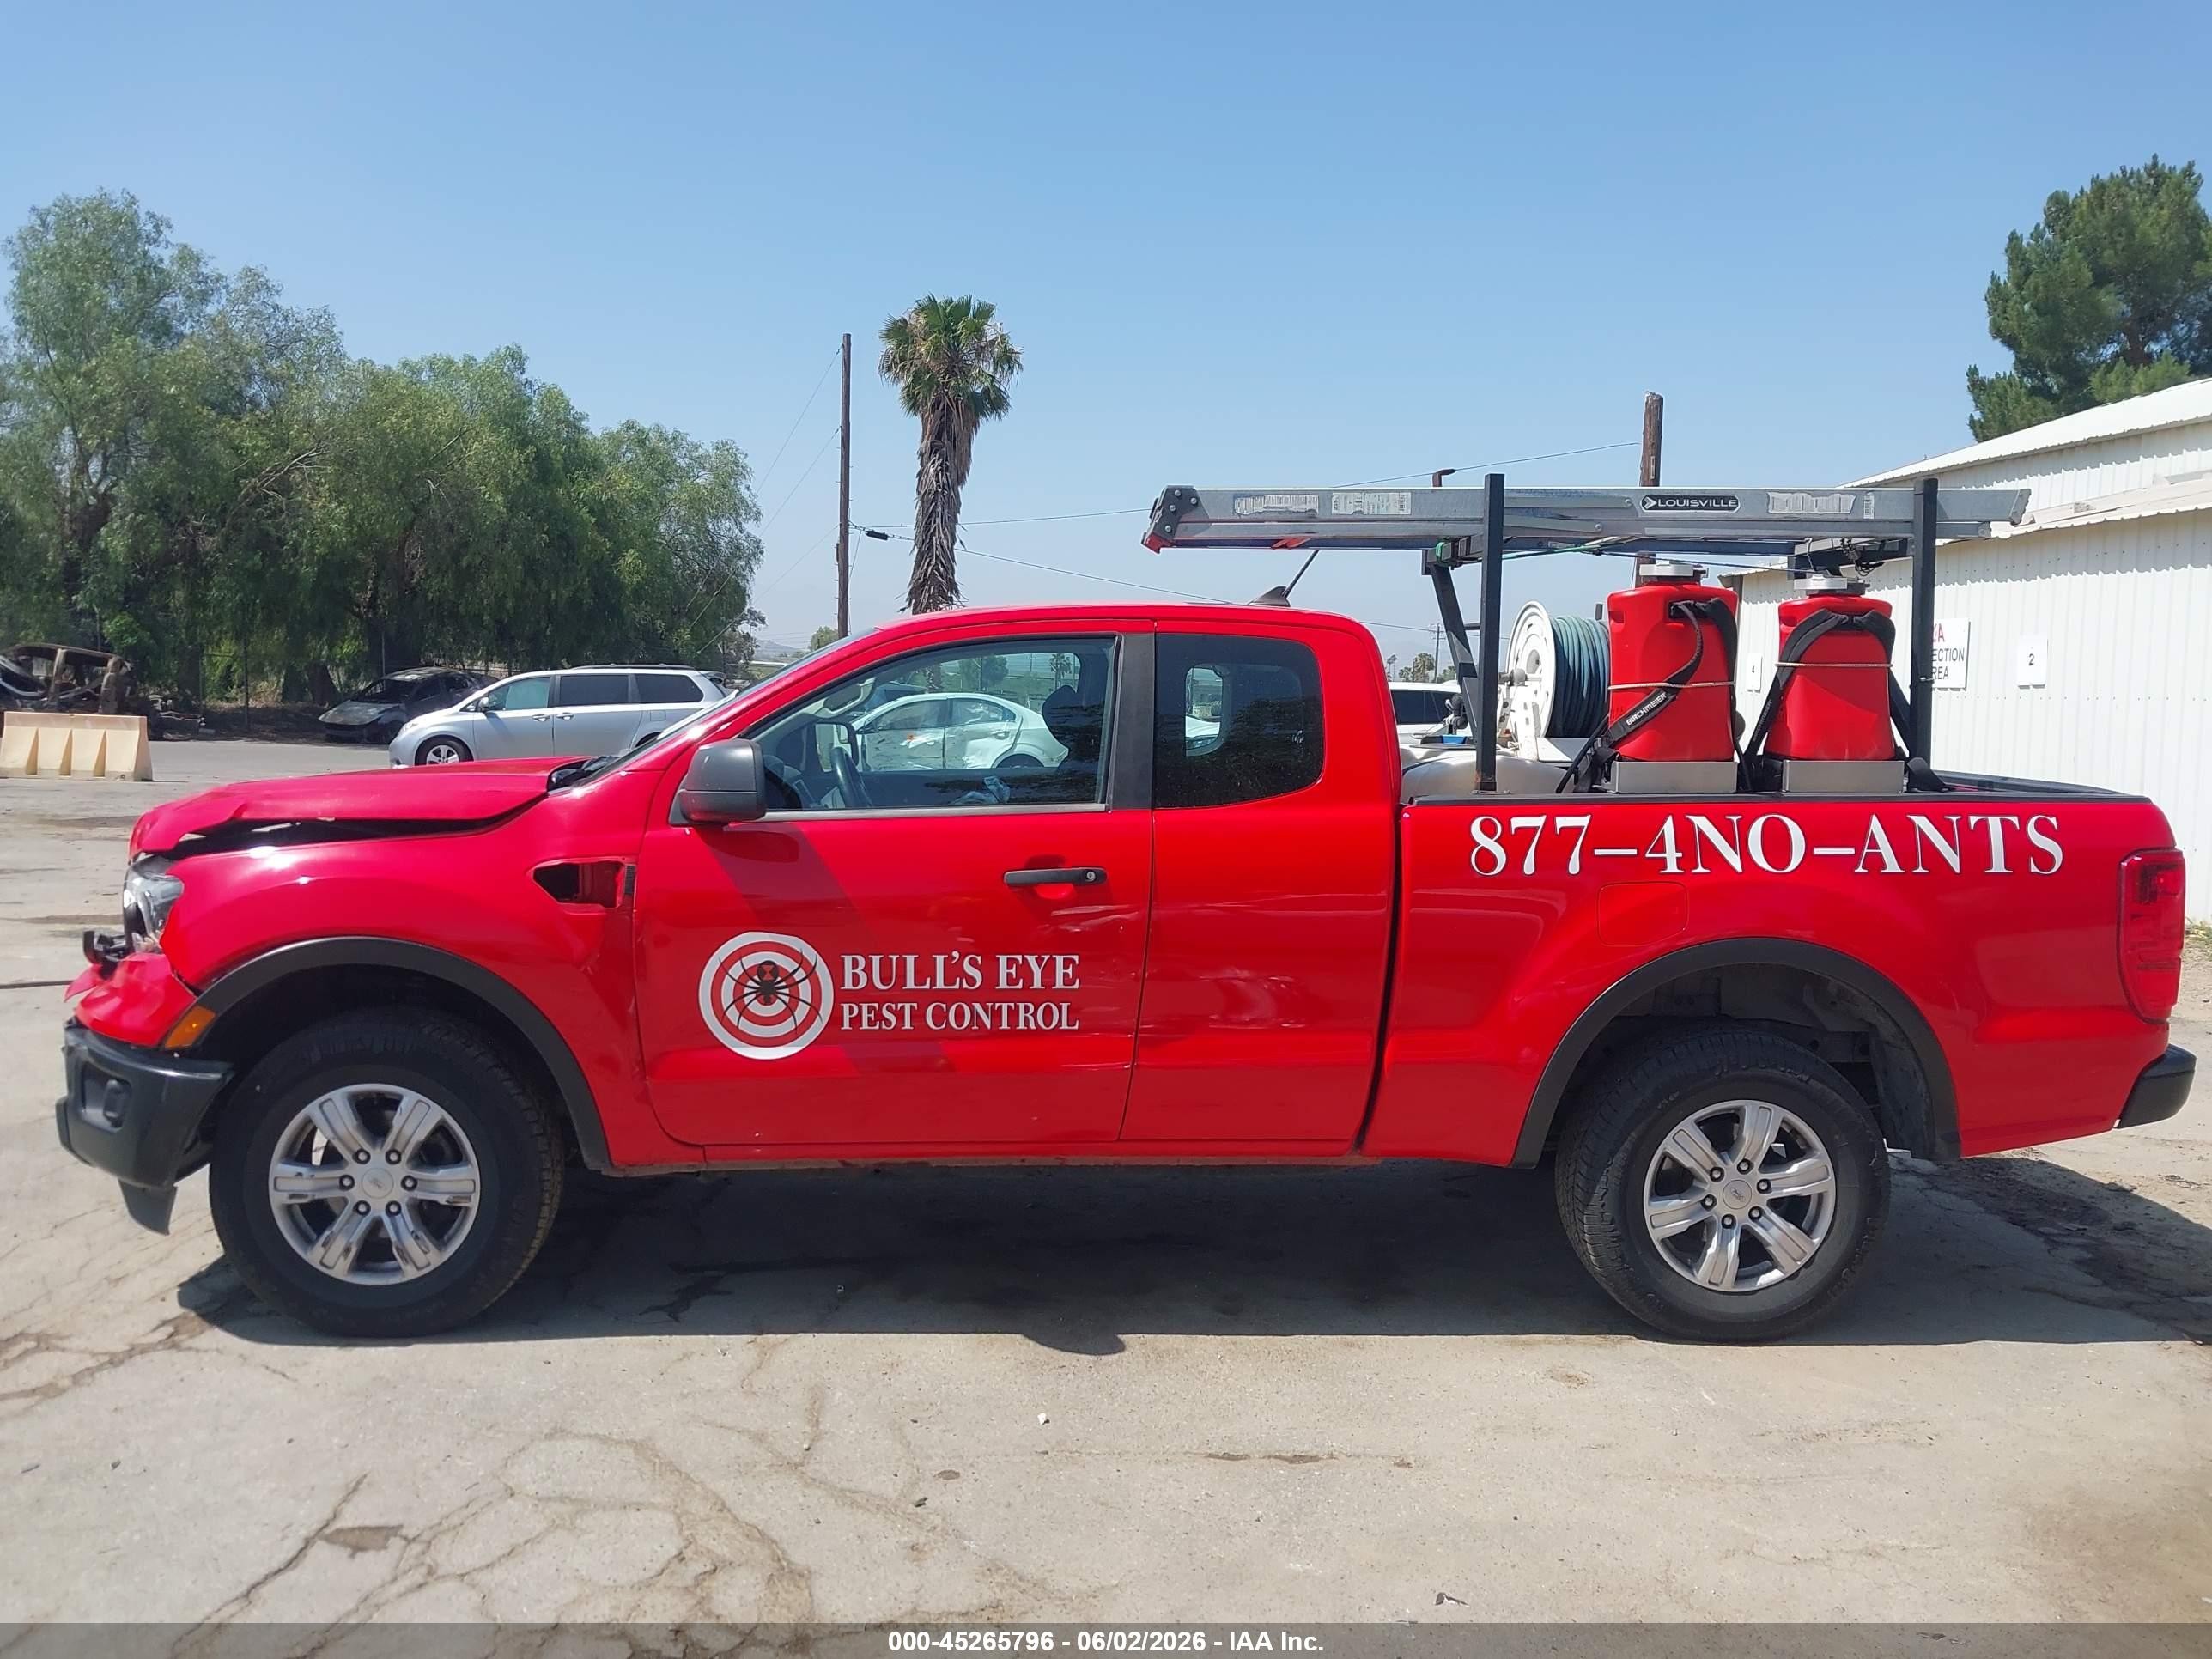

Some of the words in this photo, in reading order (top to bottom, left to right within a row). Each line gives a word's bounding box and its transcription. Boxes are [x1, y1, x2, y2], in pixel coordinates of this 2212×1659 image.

[1657, 499, 1738, 507] LOUISVILLE
[2028, 653, 2035, 666] 2
[1626, 691, 1667, 726] BIRCHMEIER
[840, 951, 983, 991] BULL'S
[995, 954, 1080, 990] EYE
[840, 1002, 918, 1030] PEST
[926, 1001, 1080, 1030] CONTROL
